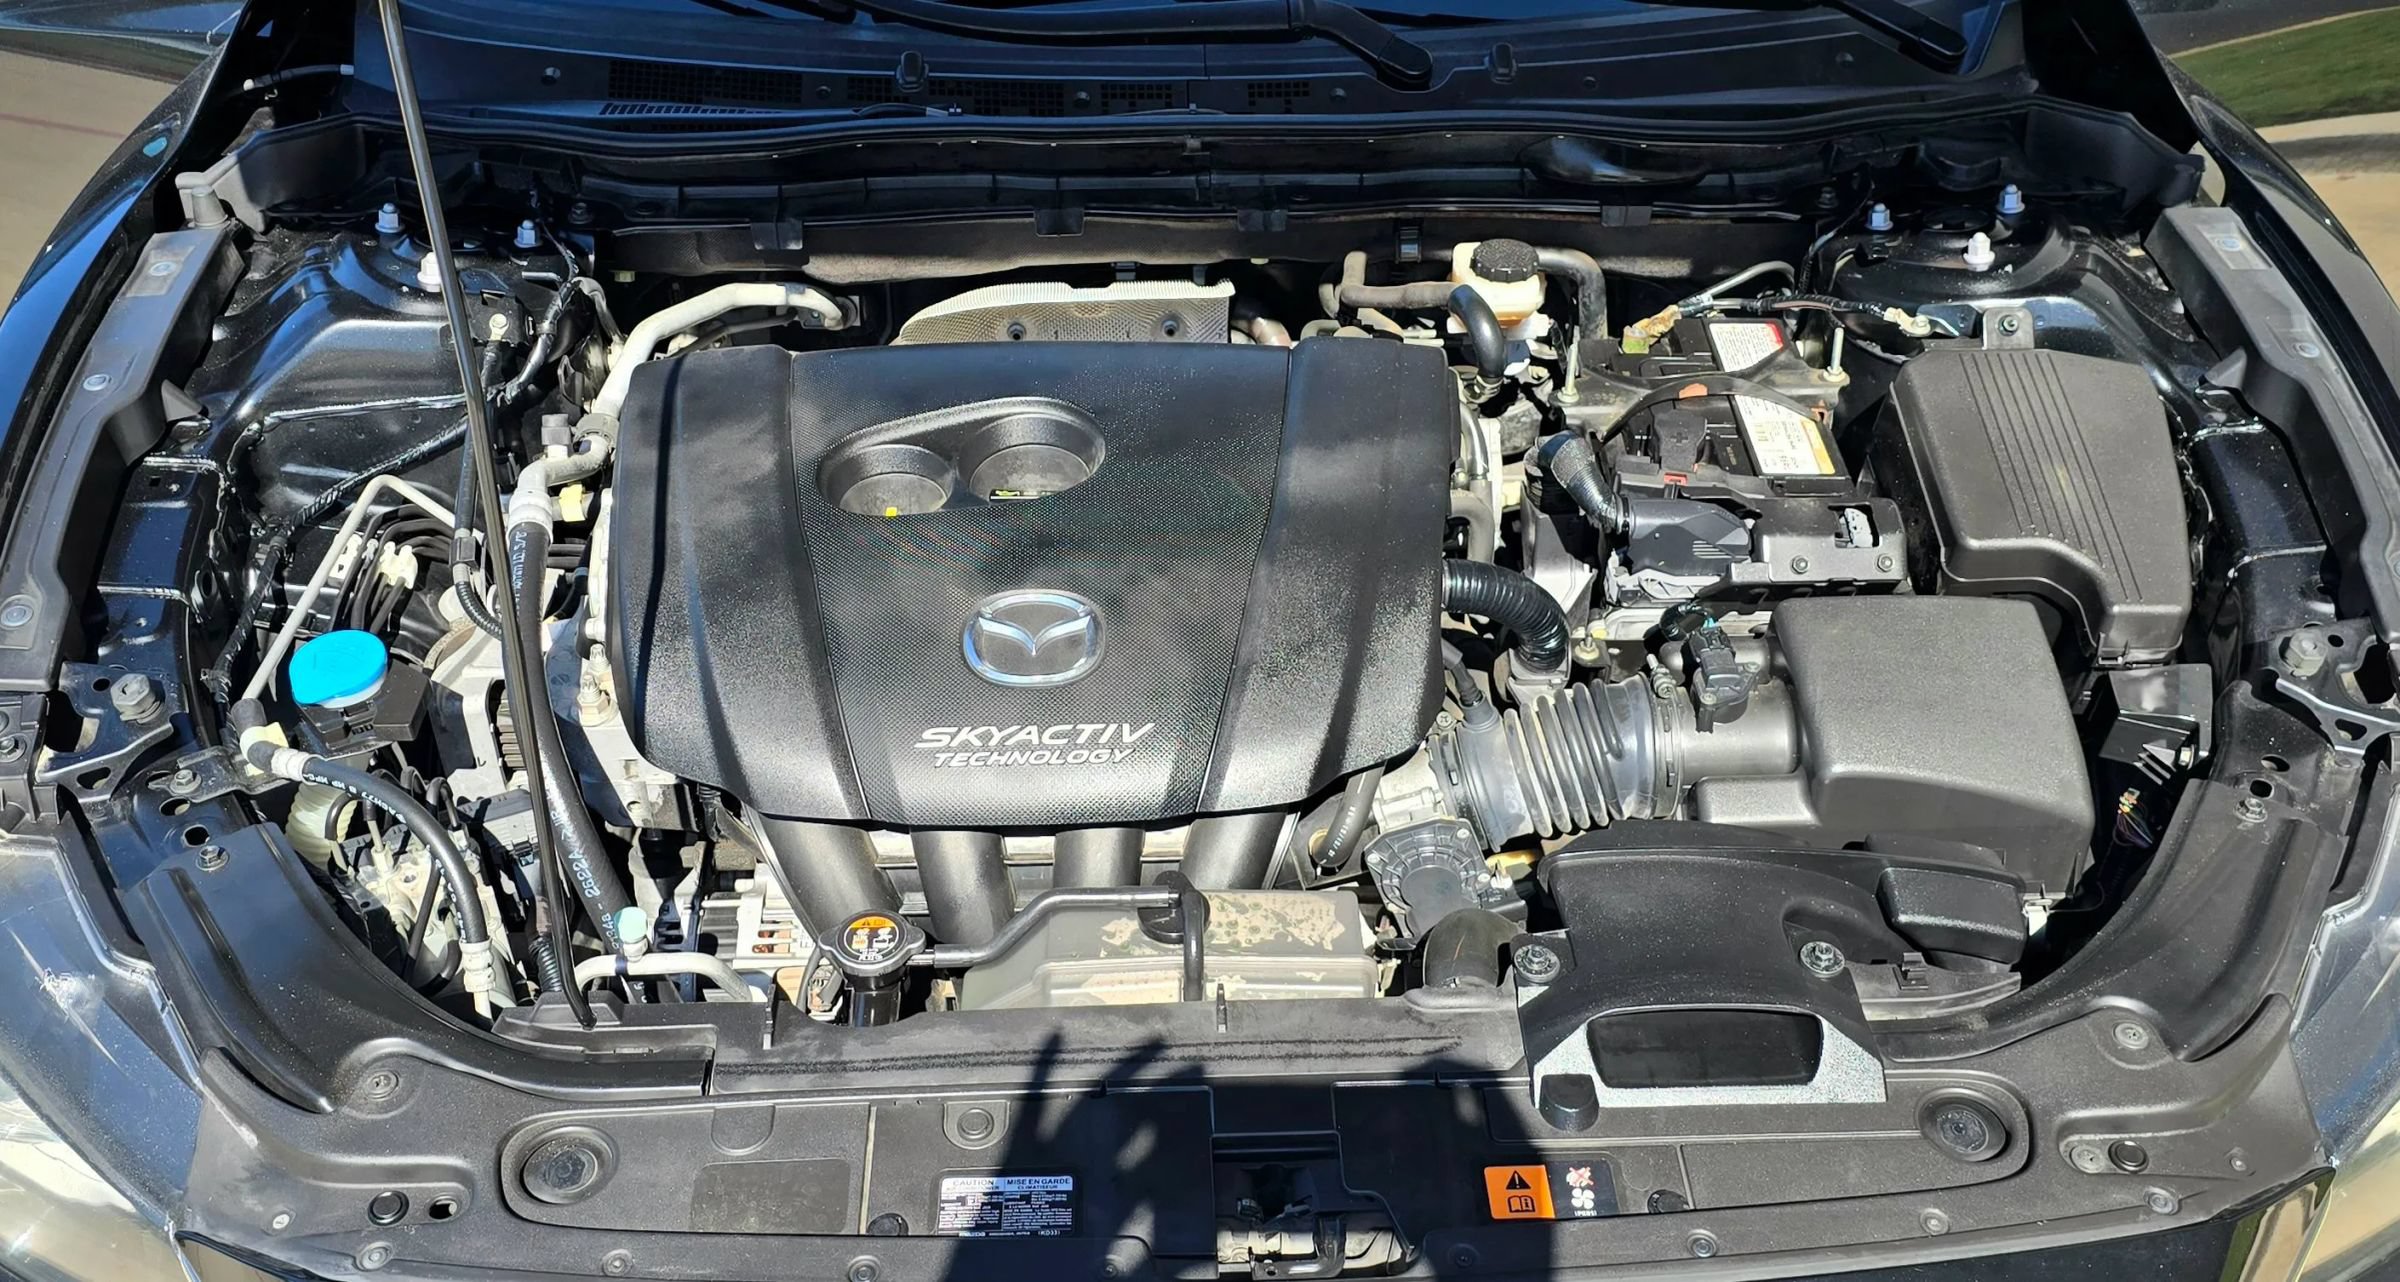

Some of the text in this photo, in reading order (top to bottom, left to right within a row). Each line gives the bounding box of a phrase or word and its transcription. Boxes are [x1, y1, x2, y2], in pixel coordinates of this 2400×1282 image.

[913, 722, 1156, 749] SKYACTIV
[934, 748, 1136, 768] TECHNOLOGY
[1041, 1177, 1070, 1185] GARDE
